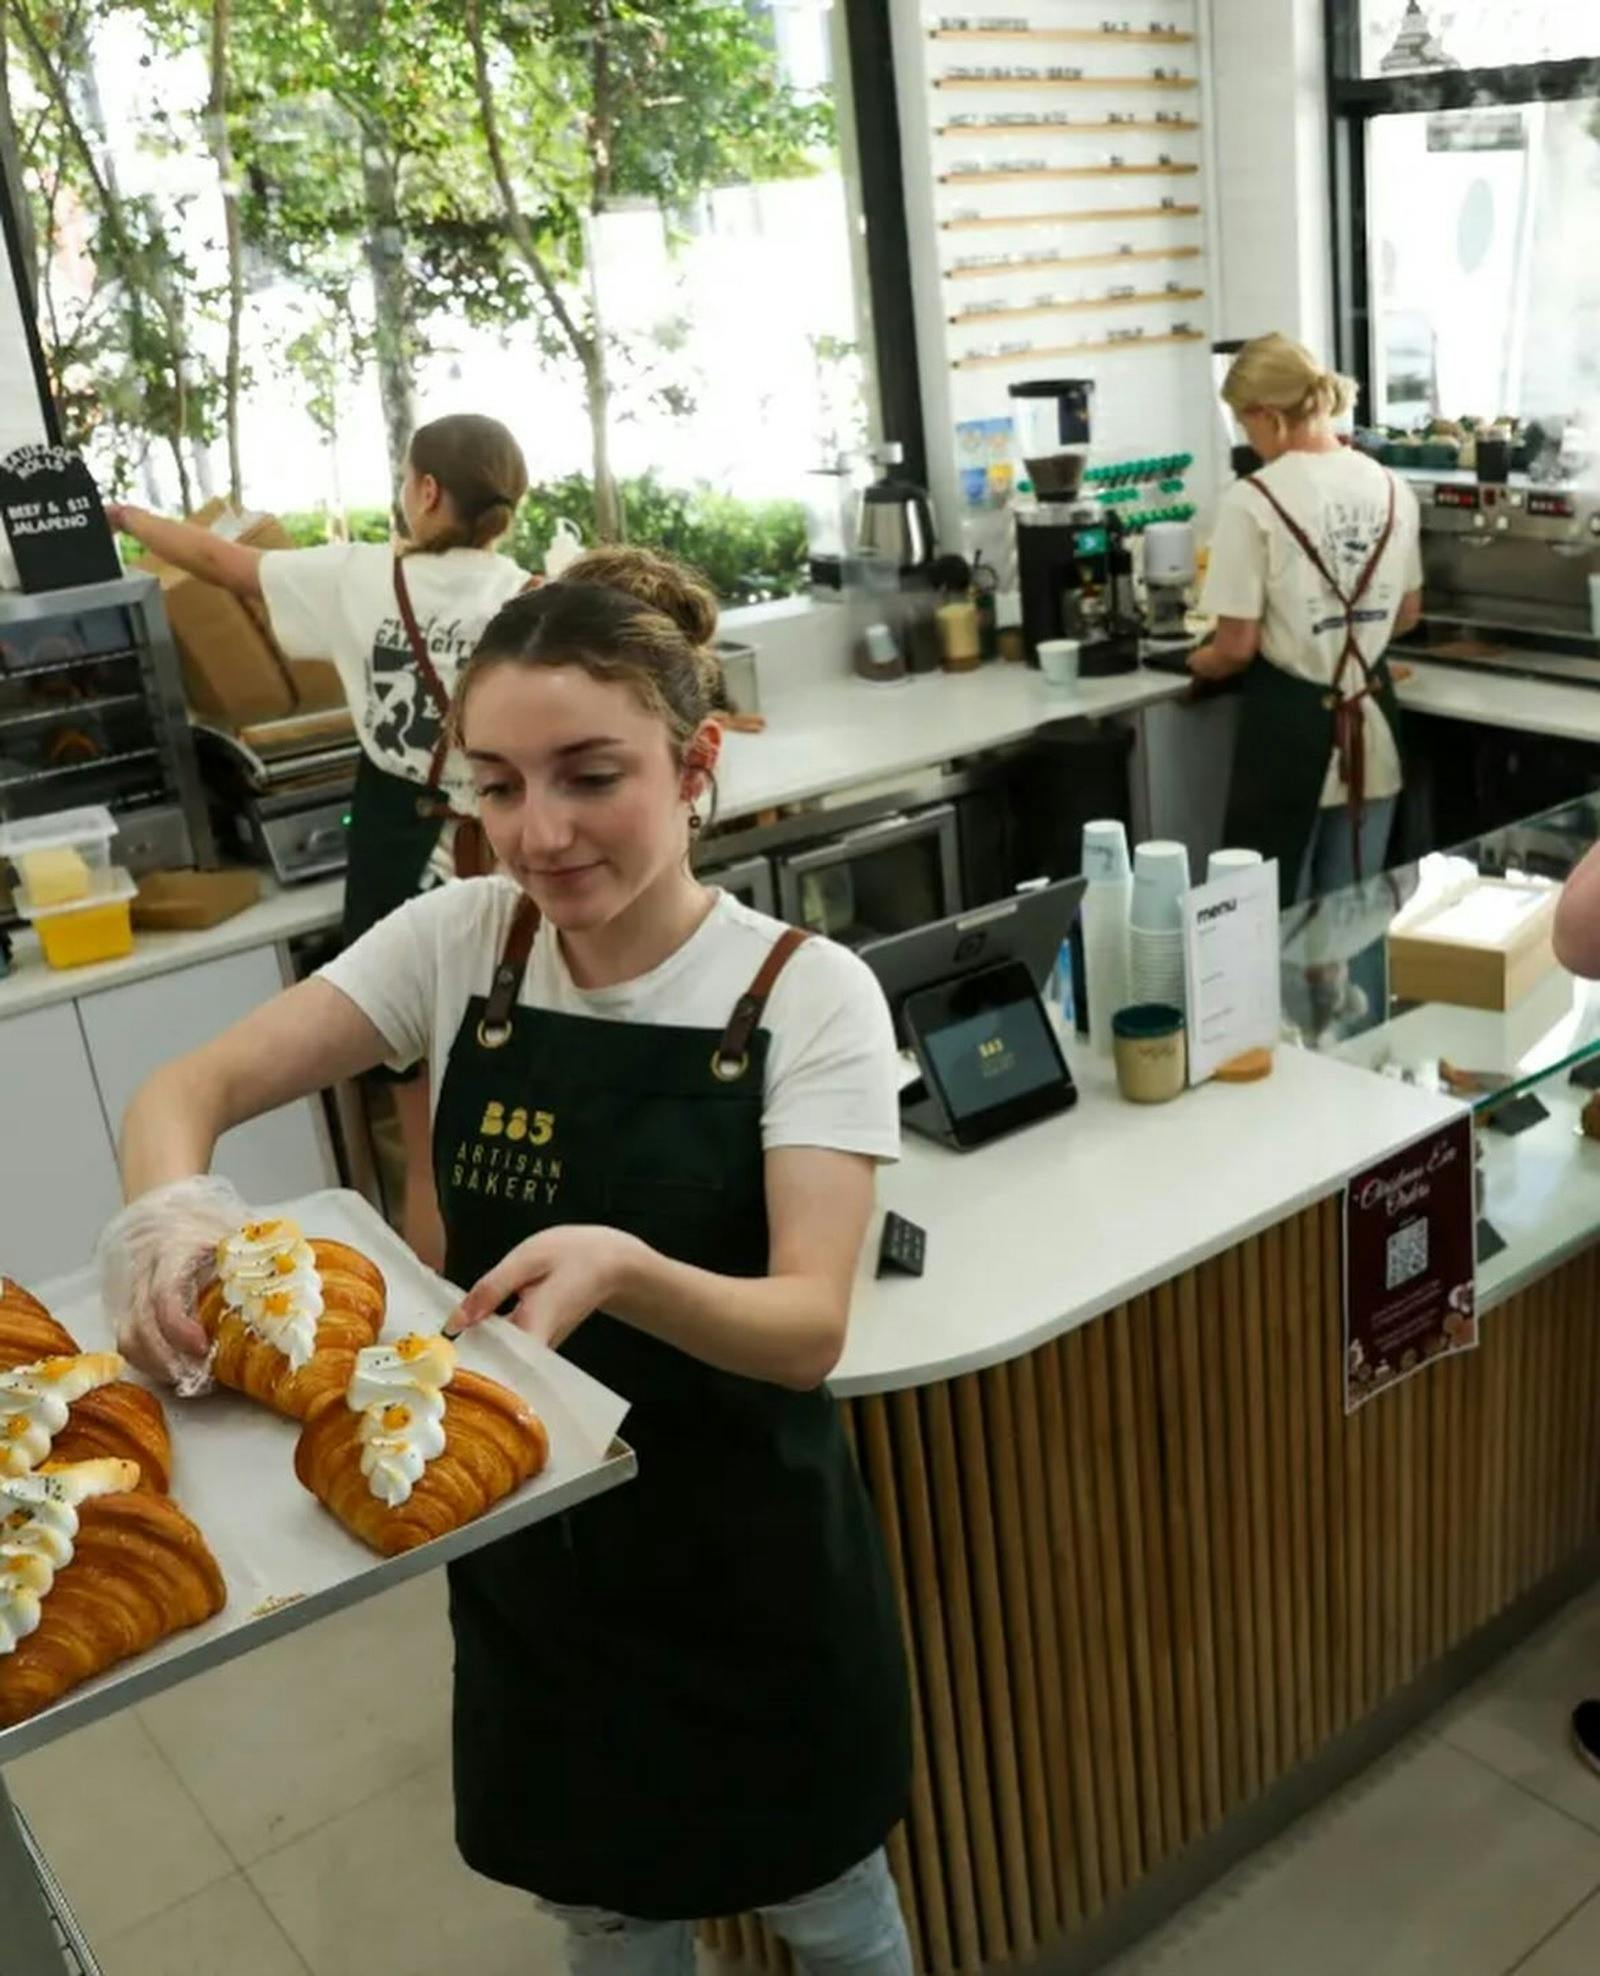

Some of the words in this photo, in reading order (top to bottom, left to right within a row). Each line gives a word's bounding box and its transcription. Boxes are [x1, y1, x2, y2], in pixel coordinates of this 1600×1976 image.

[7, 503, 41, 520] BEEF
[1197, 899, 1237, 924] menu
[457, 1141, 562, 1179] ARTISAN
[452, 1164, 558, 1205] BAKERY
